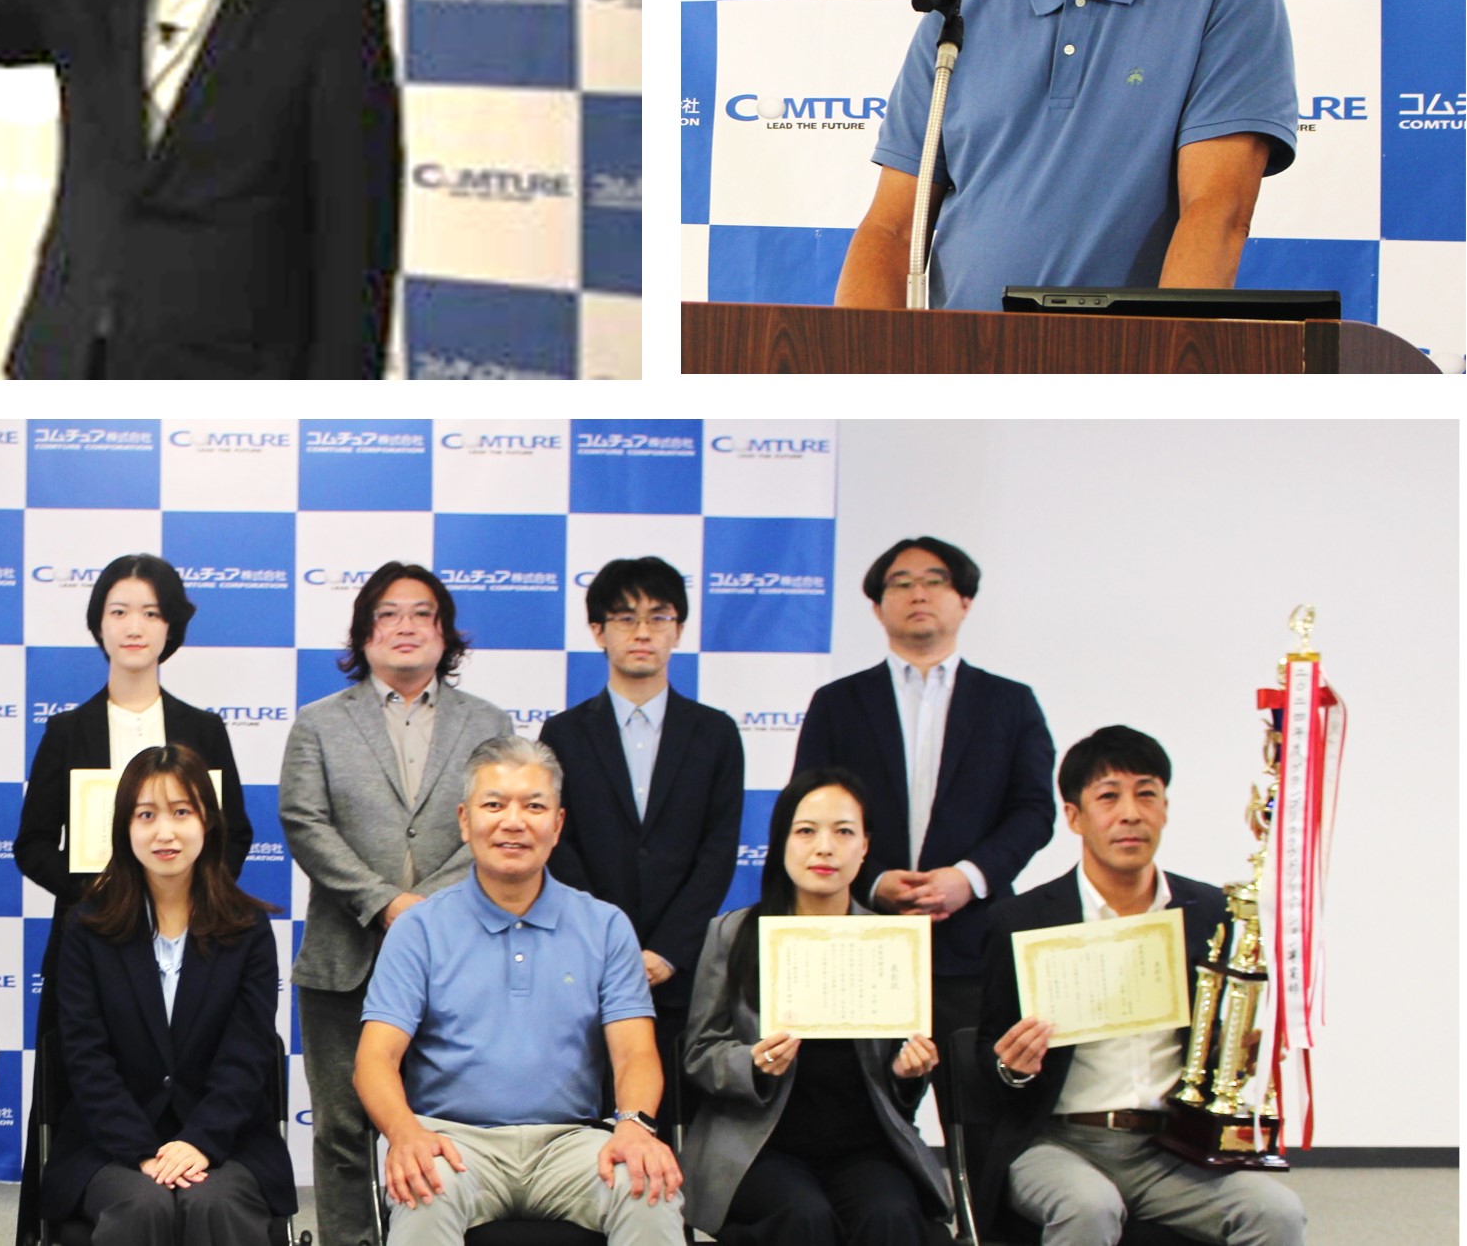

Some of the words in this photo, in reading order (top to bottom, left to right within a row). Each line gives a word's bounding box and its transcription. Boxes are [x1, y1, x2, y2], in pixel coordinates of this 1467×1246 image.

[766, 121, 793, 131] LEAD
[797, 121, 817, 131] THE
[821, 121, 865, 131] FUTURE
